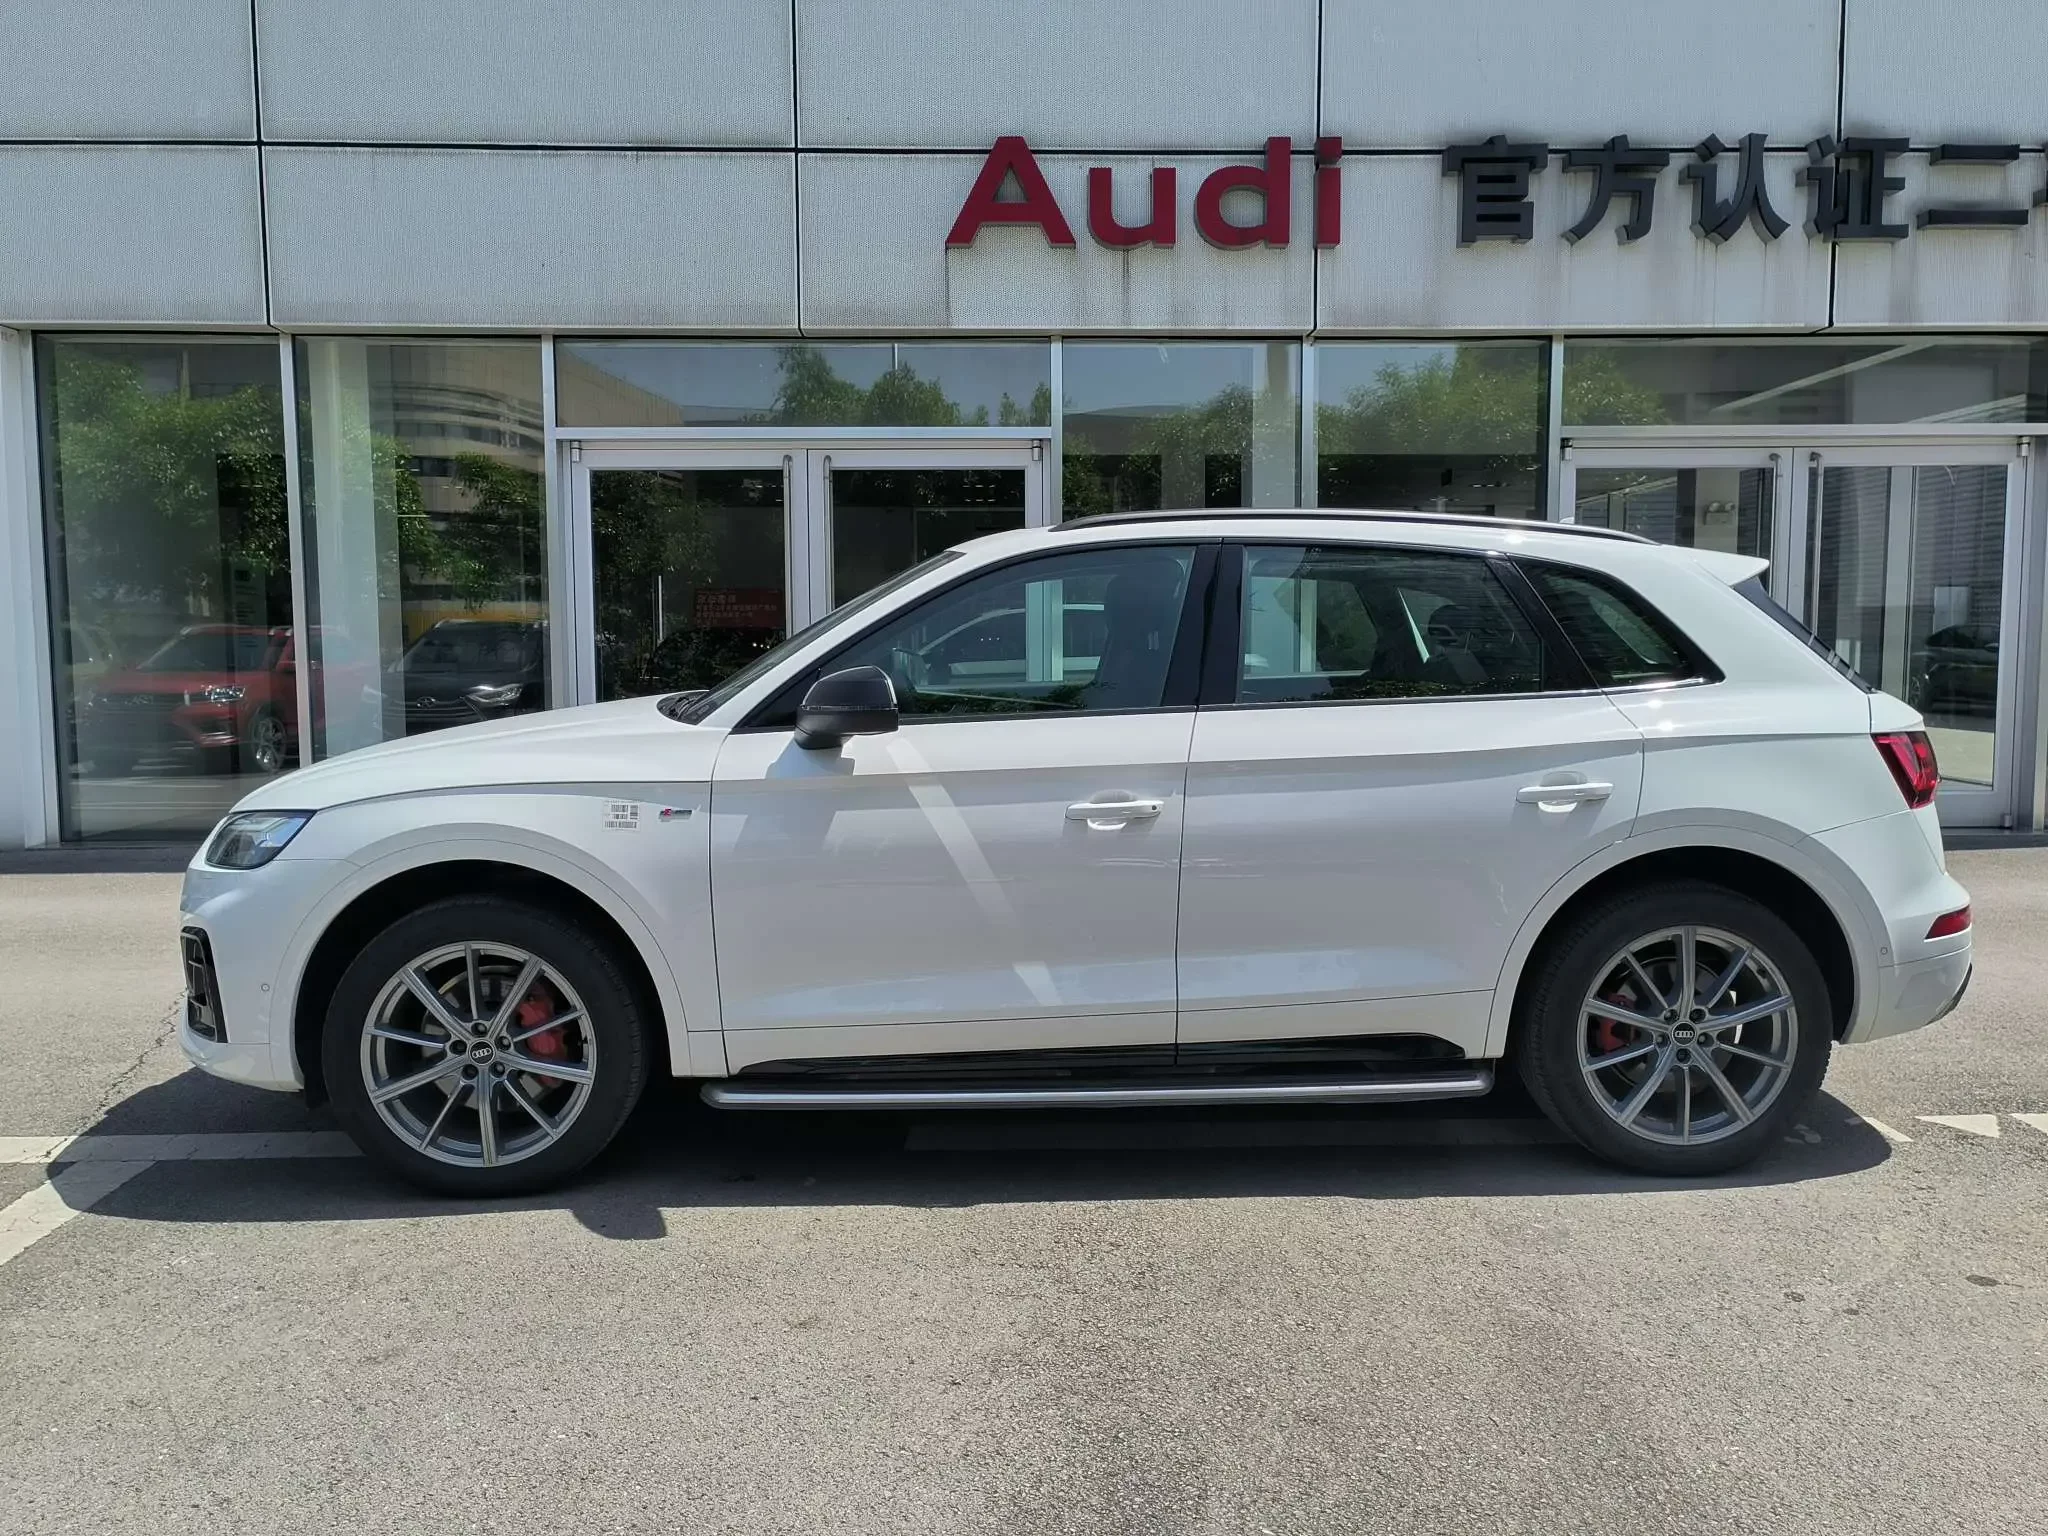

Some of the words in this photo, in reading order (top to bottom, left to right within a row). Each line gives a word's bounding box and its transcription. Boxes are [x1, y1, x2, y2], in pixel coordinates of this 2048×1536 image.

[946, 136, 1342, 249] Audi
[1442, 133, 2048, 243] 官方认证二
